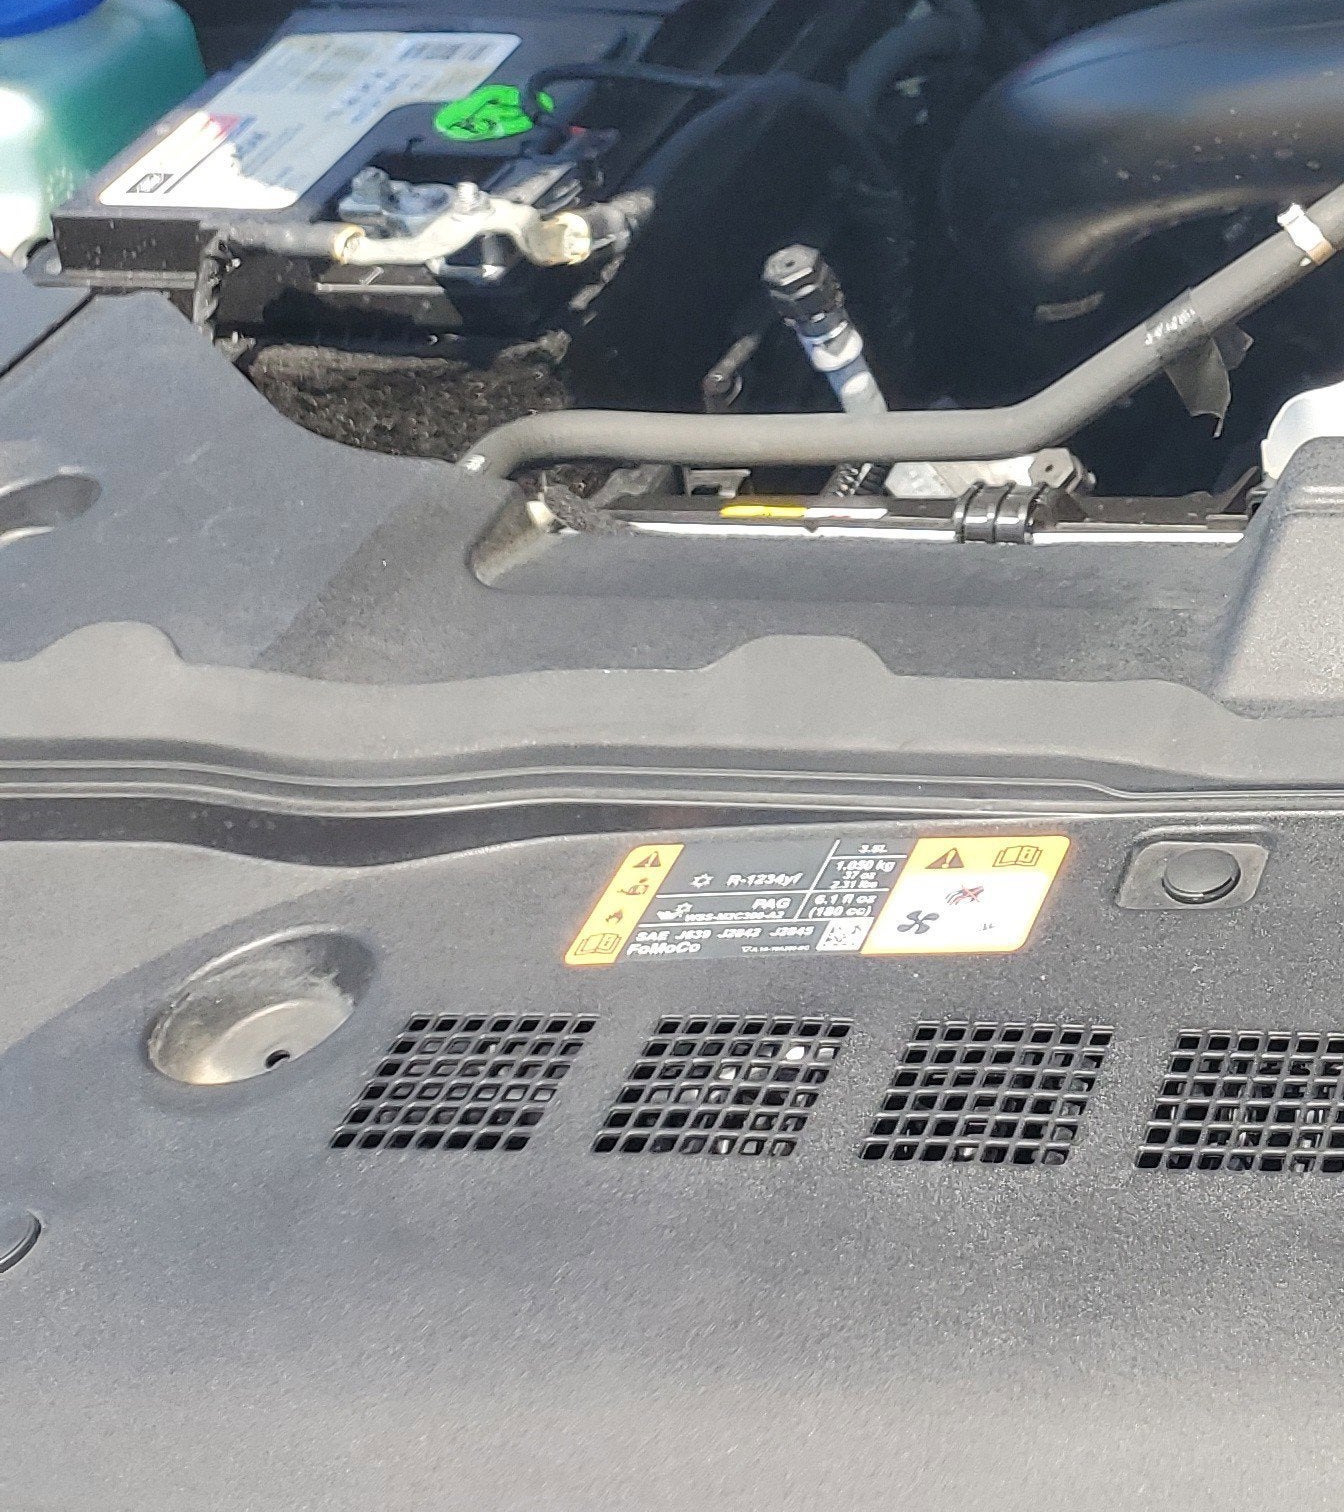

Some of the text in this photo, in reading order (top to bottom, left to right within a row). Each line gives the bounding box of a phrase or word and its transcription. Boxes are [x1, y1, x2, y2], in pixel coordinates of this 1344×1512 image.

[875, 859, 896, 873] kg
[726, 872, 803, 887] R-1234yf
[843, 870, 860, 880] 37
[752, 896, 792, 910] PAG
[814, 893, 878, 905] 6.1 fl oz
[635, 930, 671, 942] SAE
[626, 941, 702, 956] FoMoCo
